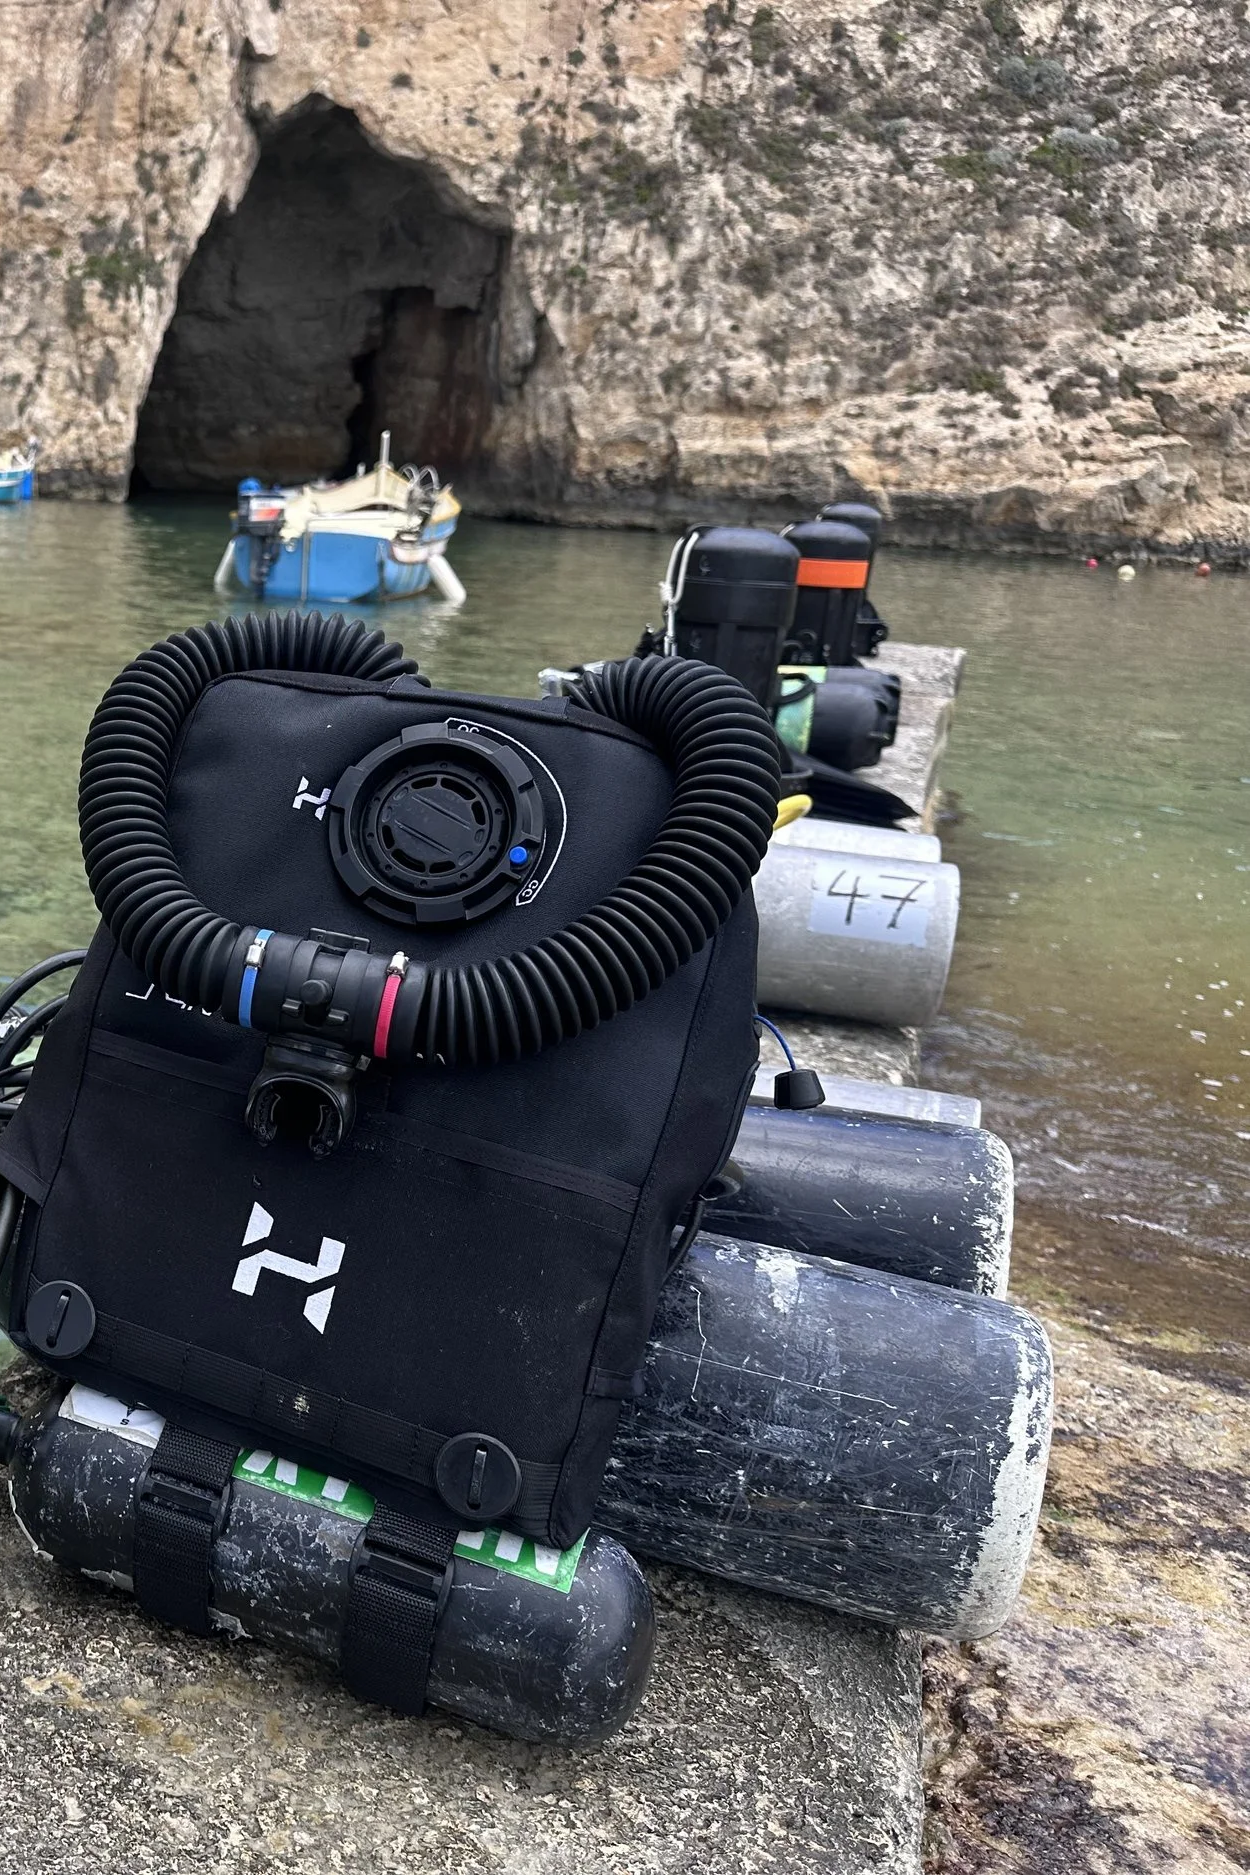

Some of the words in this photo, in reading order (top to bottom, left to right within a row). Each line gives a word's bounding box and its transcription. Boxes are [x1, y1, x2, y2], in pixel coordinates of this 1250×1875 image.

[521, 879, 539, 897] CC
[827, 869, 927, 929] 47
[119, 1418, 130, 1426] S
